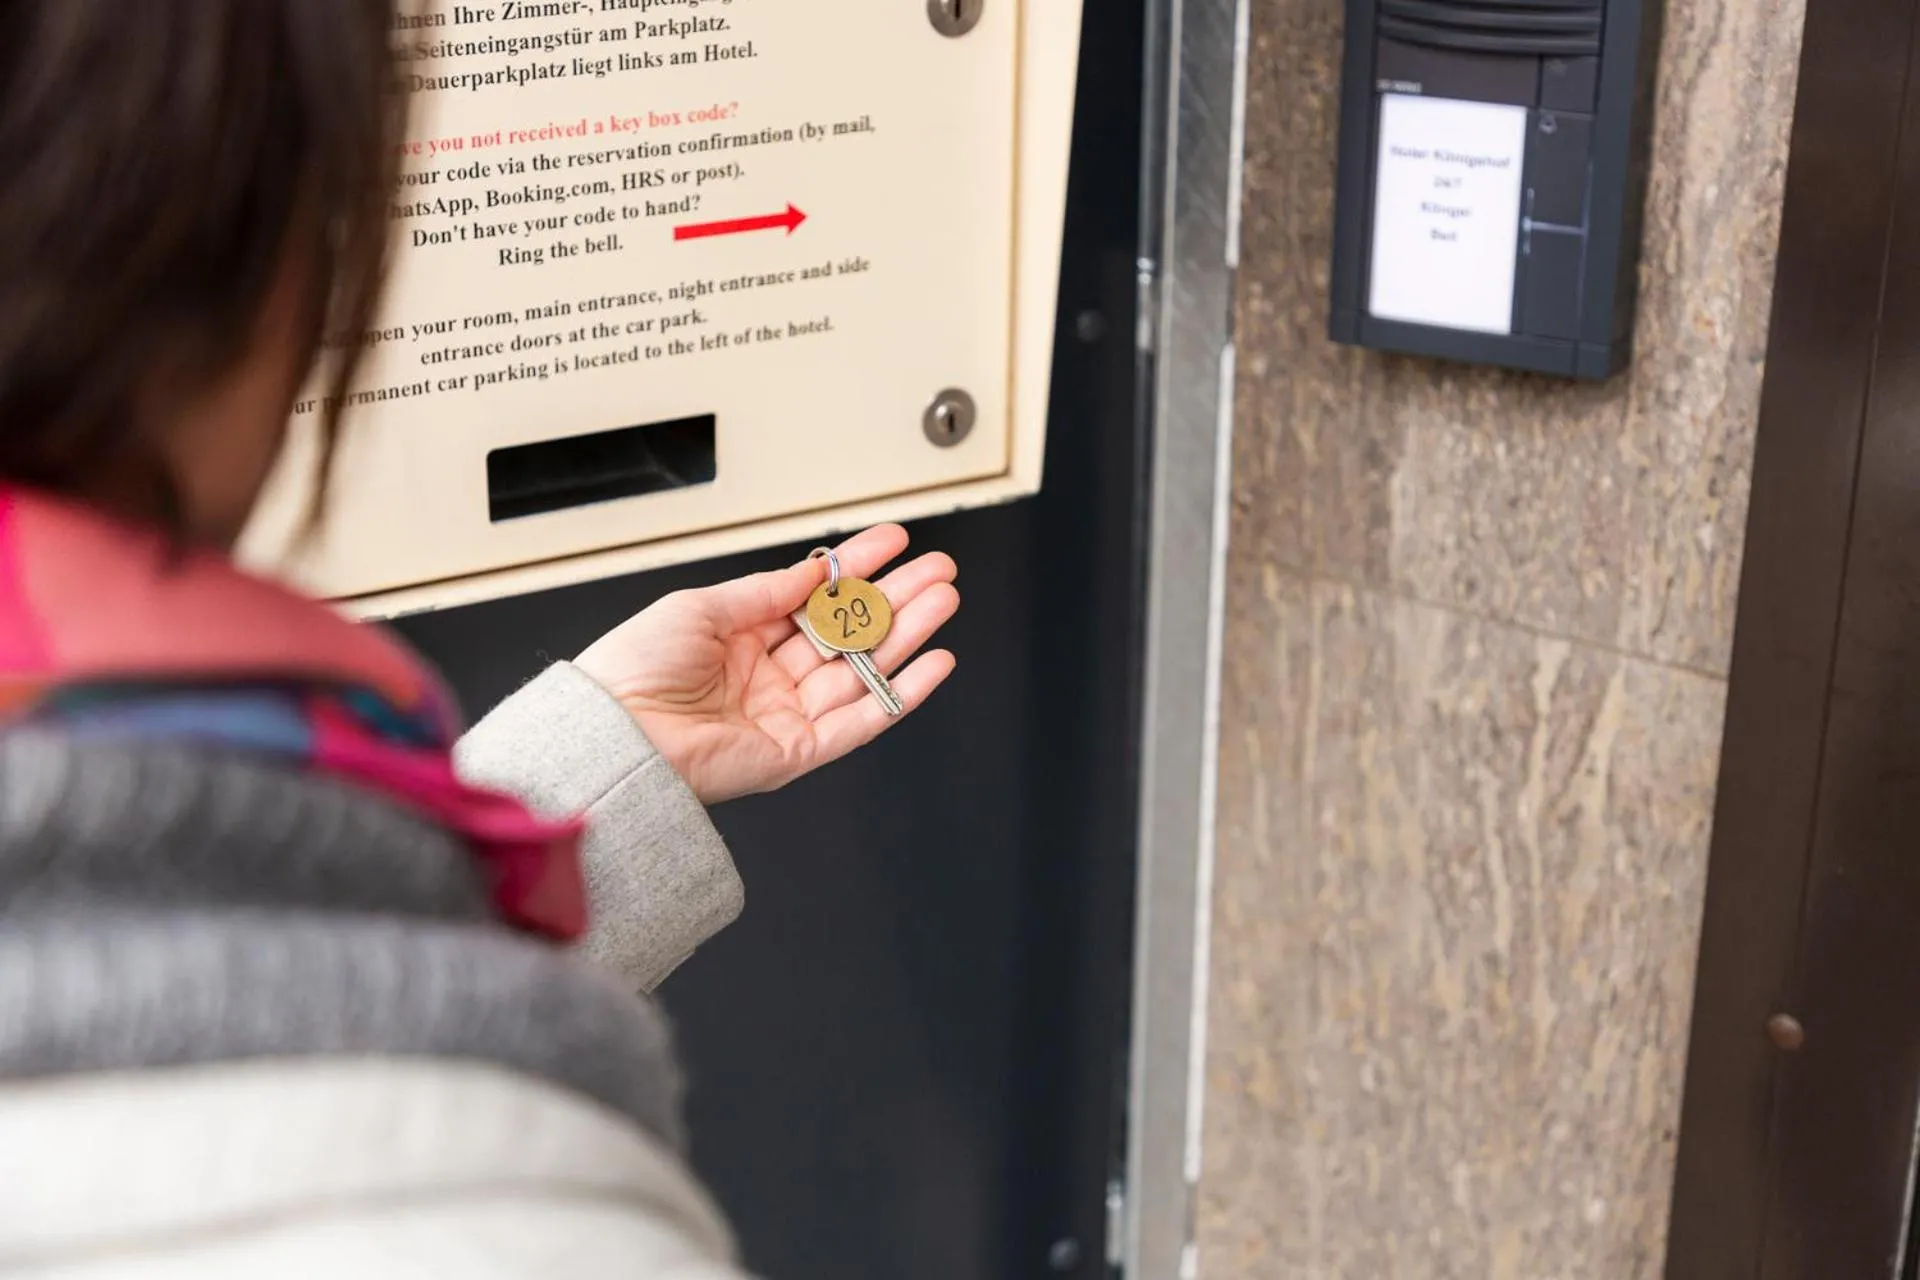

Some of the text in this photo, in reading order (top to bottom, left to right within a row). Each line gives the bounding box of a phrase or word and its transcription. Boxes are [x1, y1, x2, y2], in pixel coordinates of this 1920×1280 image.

[390, 12, 447, 30] hnen
[453, 5, 496, 25] Ihre
[501, 0, 594, 21] Zimmer-,
[415, 27, 594, 60] Seiteneingangstür
[599, 27, 628, 42] am
[634, 16, 731, 40] Parkplatz.
[409, 61, 567, 92] Dauerparkplatz
[572, 57, 613, 78] liegt
[618, 51, 664, 71] links
[669, 51, 698, 66] am
[703, 41, 758, 62] Hotel.
[428, 137, 465, 158] you
[471, 131, 502, 149] not
[508, 118, 587, 145] received
[593, 121, 605, 135] a
[611, 115, 642, 135] key
[648, 111, 682, 128] box
[687, 102, 739, 124] code?
[446, 161, 491, 182] code
[497, 157, 526, 175] via
[532, 153, 562, 172] the
[567, 141, 672, 168] reservation
[677, 128, 794, 154] confirmation
[798, 121, 826, 142] (by
[832, 115, 876, 136] mail,
[390, 163, 745, 219] hatsApp, Booking.com, HRS or post).
[411, 194, 701, 248] Don't have your code to hand?
[498, 233, 624, 267] Ring the bell.
[364, 326, 405, 349] pen
[411, 319, 458, 343] your
[462, 311, 519, 331] room,
[524, 300, 572, 321] main
[577, 290, 663, 313] entrance,
[668, 279, 714, 302] night
[719, 270, 796, 293] entrance
[800, 260, 833, 281] and
[838, 255, 871, 275] side
[420, 308, 708, 366] entrance doors at the car park.
[437, 373, 469, 392] car
[474, 362, 549, 388] parking
[554, 355, 569, 374] is
[574, 345, 639, 371] located
[645, 344, 662, 360] to
[668, 337, 695, 356] the
[700, 331, 729, 352] left
[733, 327, 752, 346] of
[755, 323, 783, 343] the
[787, 316, 834, 338] hotel.
[833, 598, 872, 638] 29
